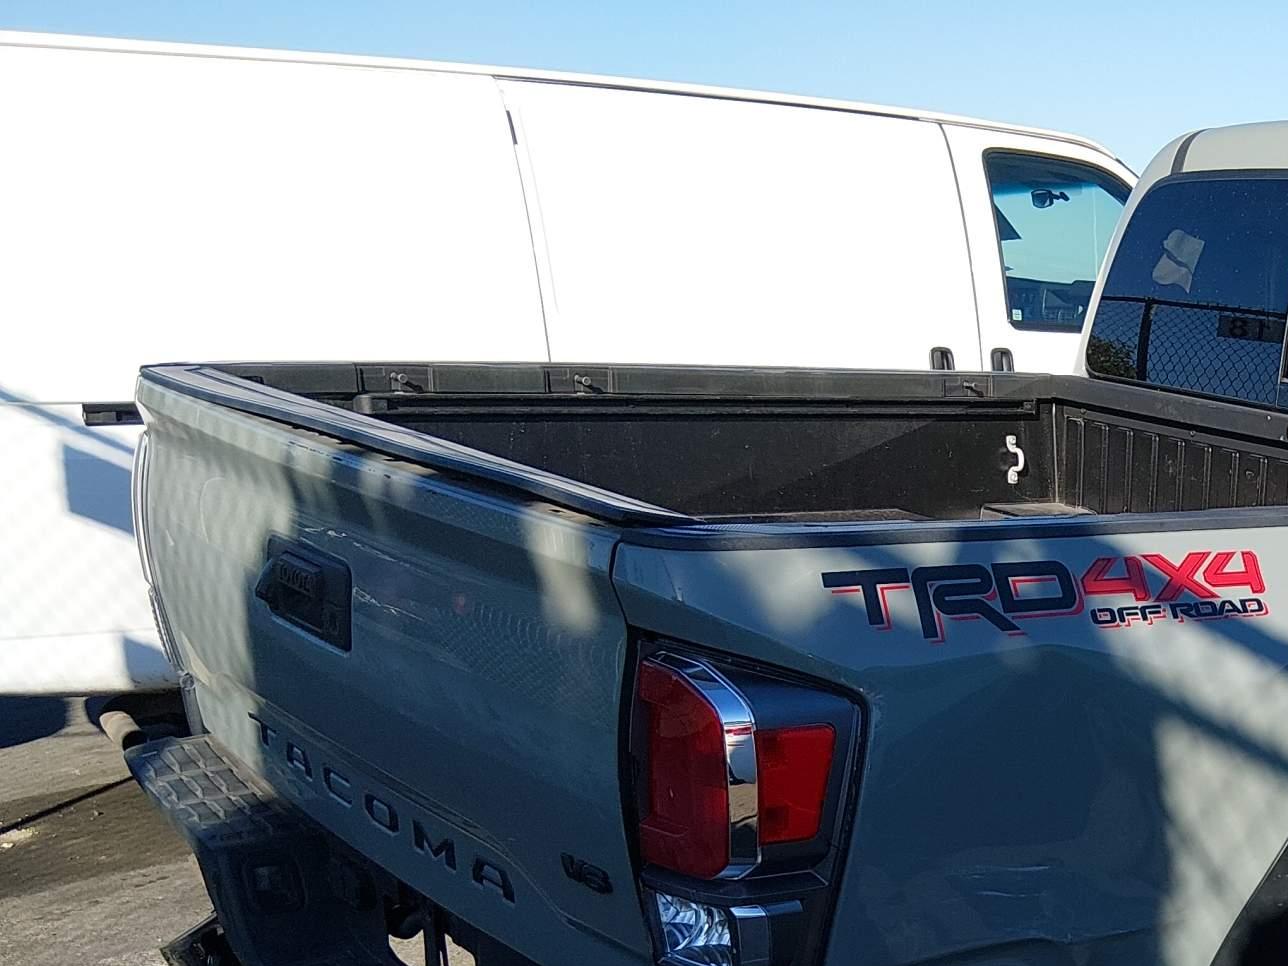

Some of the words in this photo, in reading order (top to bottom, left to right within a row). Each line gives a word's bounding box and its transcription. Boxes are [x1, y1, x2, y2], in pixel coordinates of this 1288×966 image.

[820, 560, 1084, 643] TRD
[1081, 549, 1267, 602] 4X4
[1091, 604, 1168, 628] OFF
[1169, 597, 1269, 624] ROAD
[247, 711, 515, 903] TACOMA
[560, 852, 613, 894] V6
